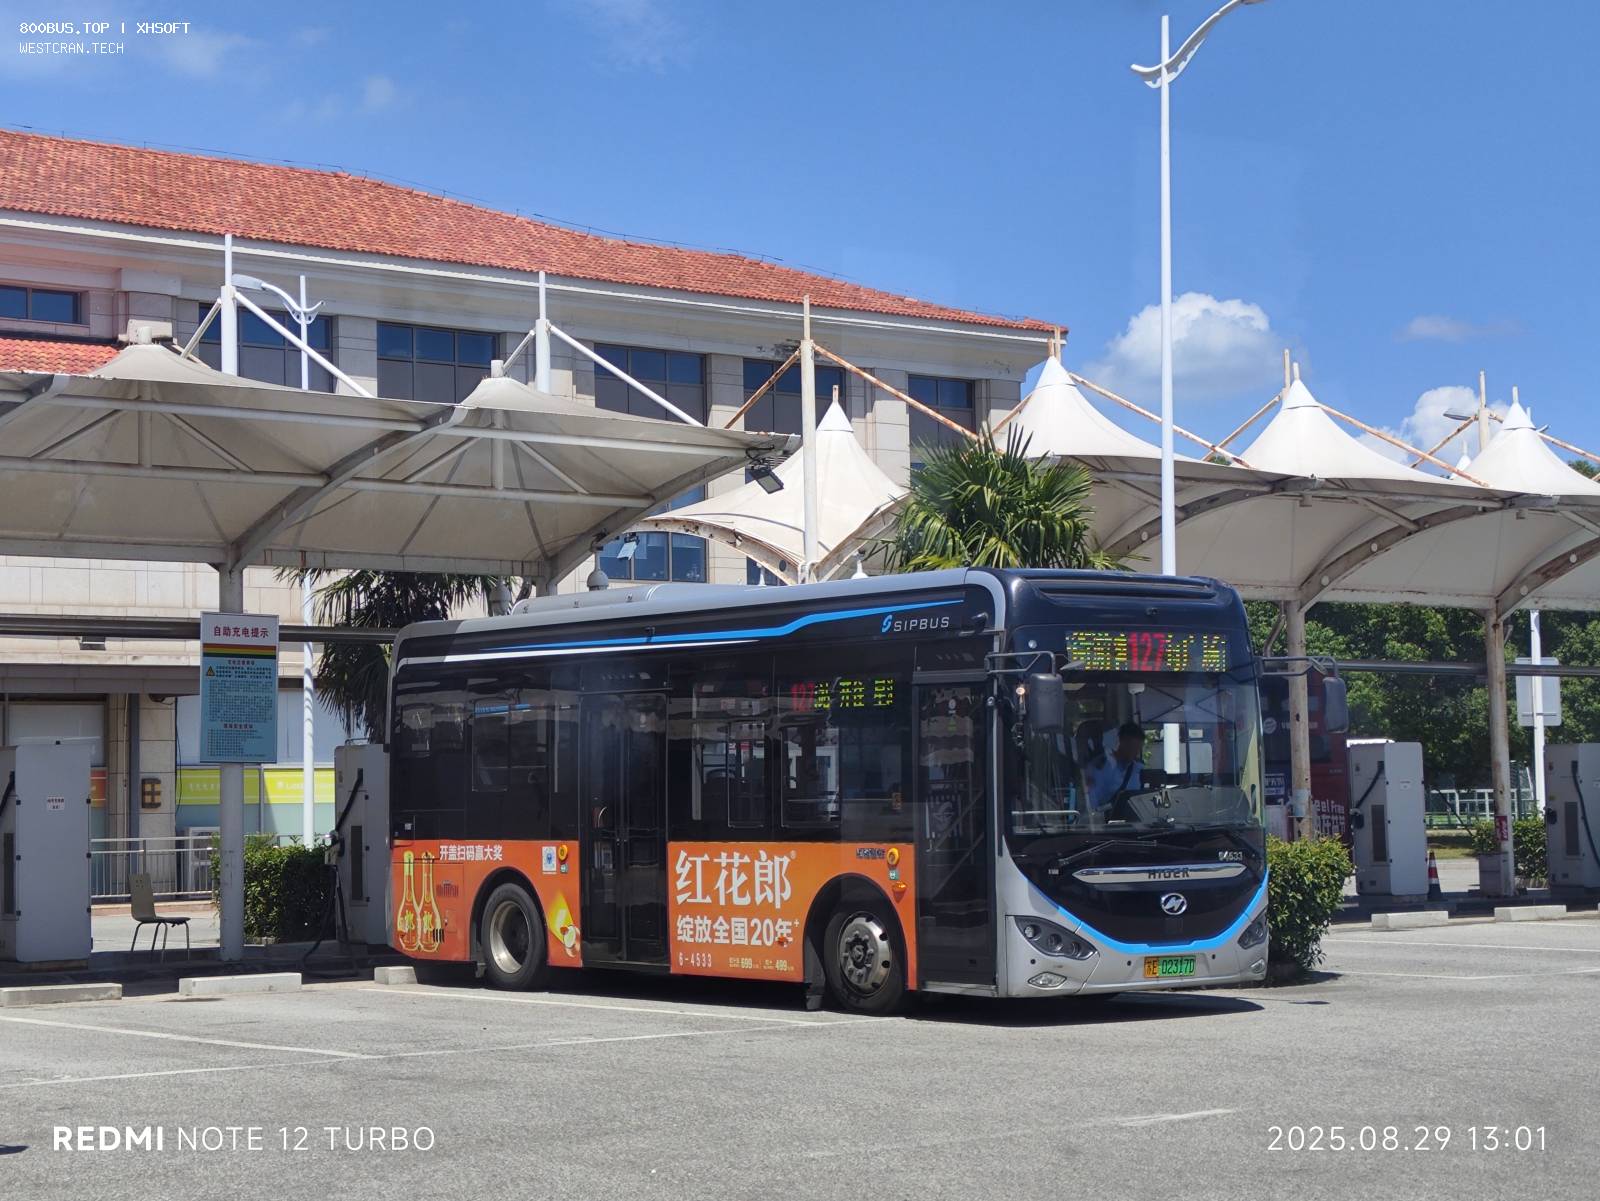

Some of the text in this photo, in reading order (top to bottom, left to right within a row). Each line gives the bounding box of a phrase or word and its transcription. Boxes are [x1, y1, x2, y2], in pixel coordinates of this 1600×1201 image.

[213, 625, 269, 638] 自助充电提示
[893, 616, 950, 632] SIPBUS
[1128, 632, 1165, 671] 127
[439, 845, 503, 861] 开盖扫码赢大奖
[675, 850, 791, 909] 红花郎
[1148, 867, 1190, 879] HIGER
[678, 952, 713, 968] 6-4533
